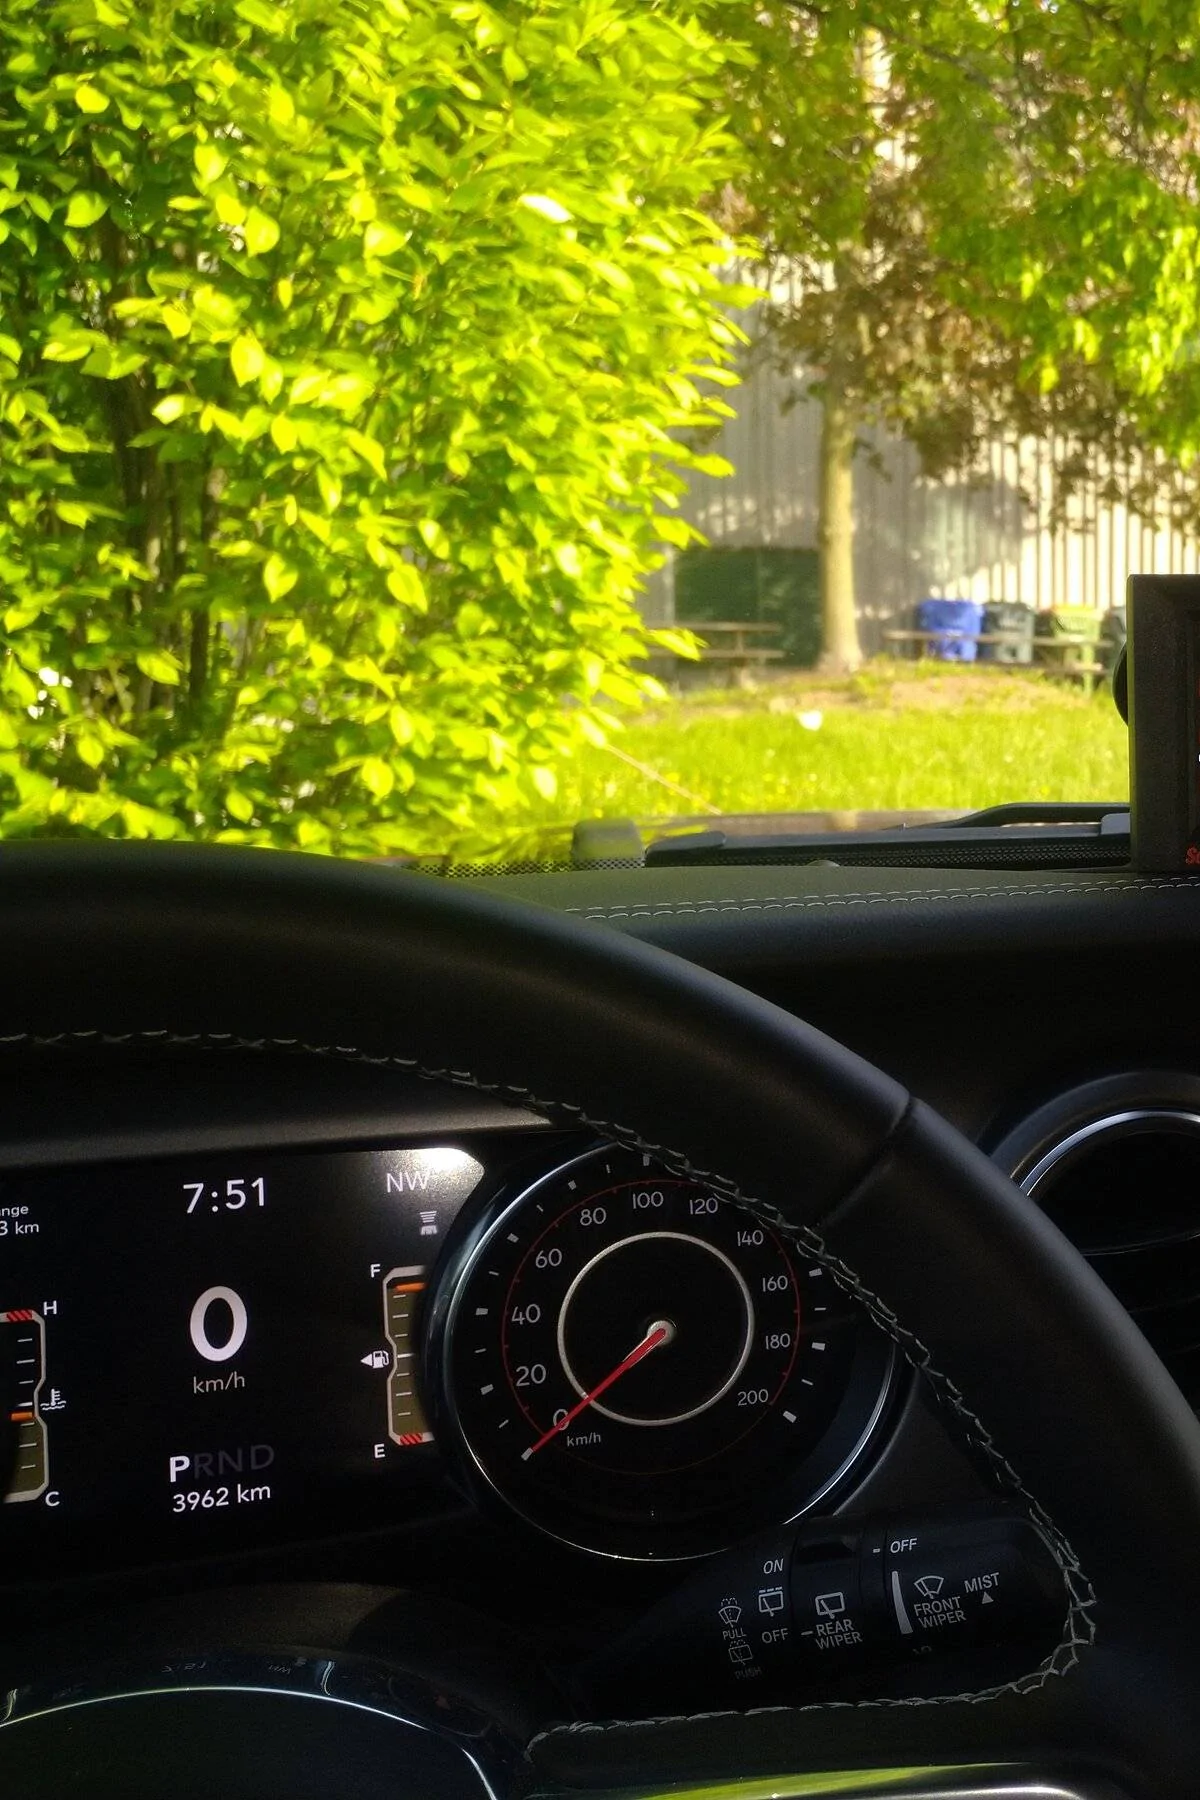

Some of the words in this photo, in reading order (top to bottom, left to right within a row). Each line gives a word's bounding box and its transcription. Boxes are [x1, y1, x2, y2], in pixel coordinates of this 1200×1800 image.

[386, 1172, 430, 1193] NW
[182, 1177, 266, 1214] 7:51
[631, 1191, 664, 1209] 100
[0, 1205, 29, 1218] nge
[688, 1198, 719, 1215] 120
[579, 1207, 608, 1226] 80
[15, 1221, 39, 1234] km
[736, 1230, 764, 1246] 140
[535, 1248, 563, 1269] 60
[370, 1263, 381, 1277] F
[761, 1275, 789, 1292] 160
[43, 1301, 57, 1315] H
[511, 1304, 541, 1325] 40
[189, 1285, 248, 1362] 0
[764, 1333, 792, 1350] 180
[192, 1372, 246, 1394] km/h
[515, 1364, 547, 1387] 20
[737, 1388, 769, 1407] 200
[566, 1431, 602, 1447] km/h
[374, 1444, 386, 1458] E
[45, 1491, 60, 1506] C
[172, 1487, 229, 1513] 3962
[236, 1483, 272, 1505] km
[890, 1538, 918, 1554] OFF
[763, 1558, 784, 1574] ON
[964, 1572, 1000, 1594] MIST
[913, 1596, 962, 1617] FRONT
[816, 1619, 854, 1637] REAR
[917, 1610, 967, 1629] WIPER
[722, 1630, 746, 1640] PULL
[761, 1628, 789, 1644] OFF
[815, 1630, 863, 1650] WIPER
